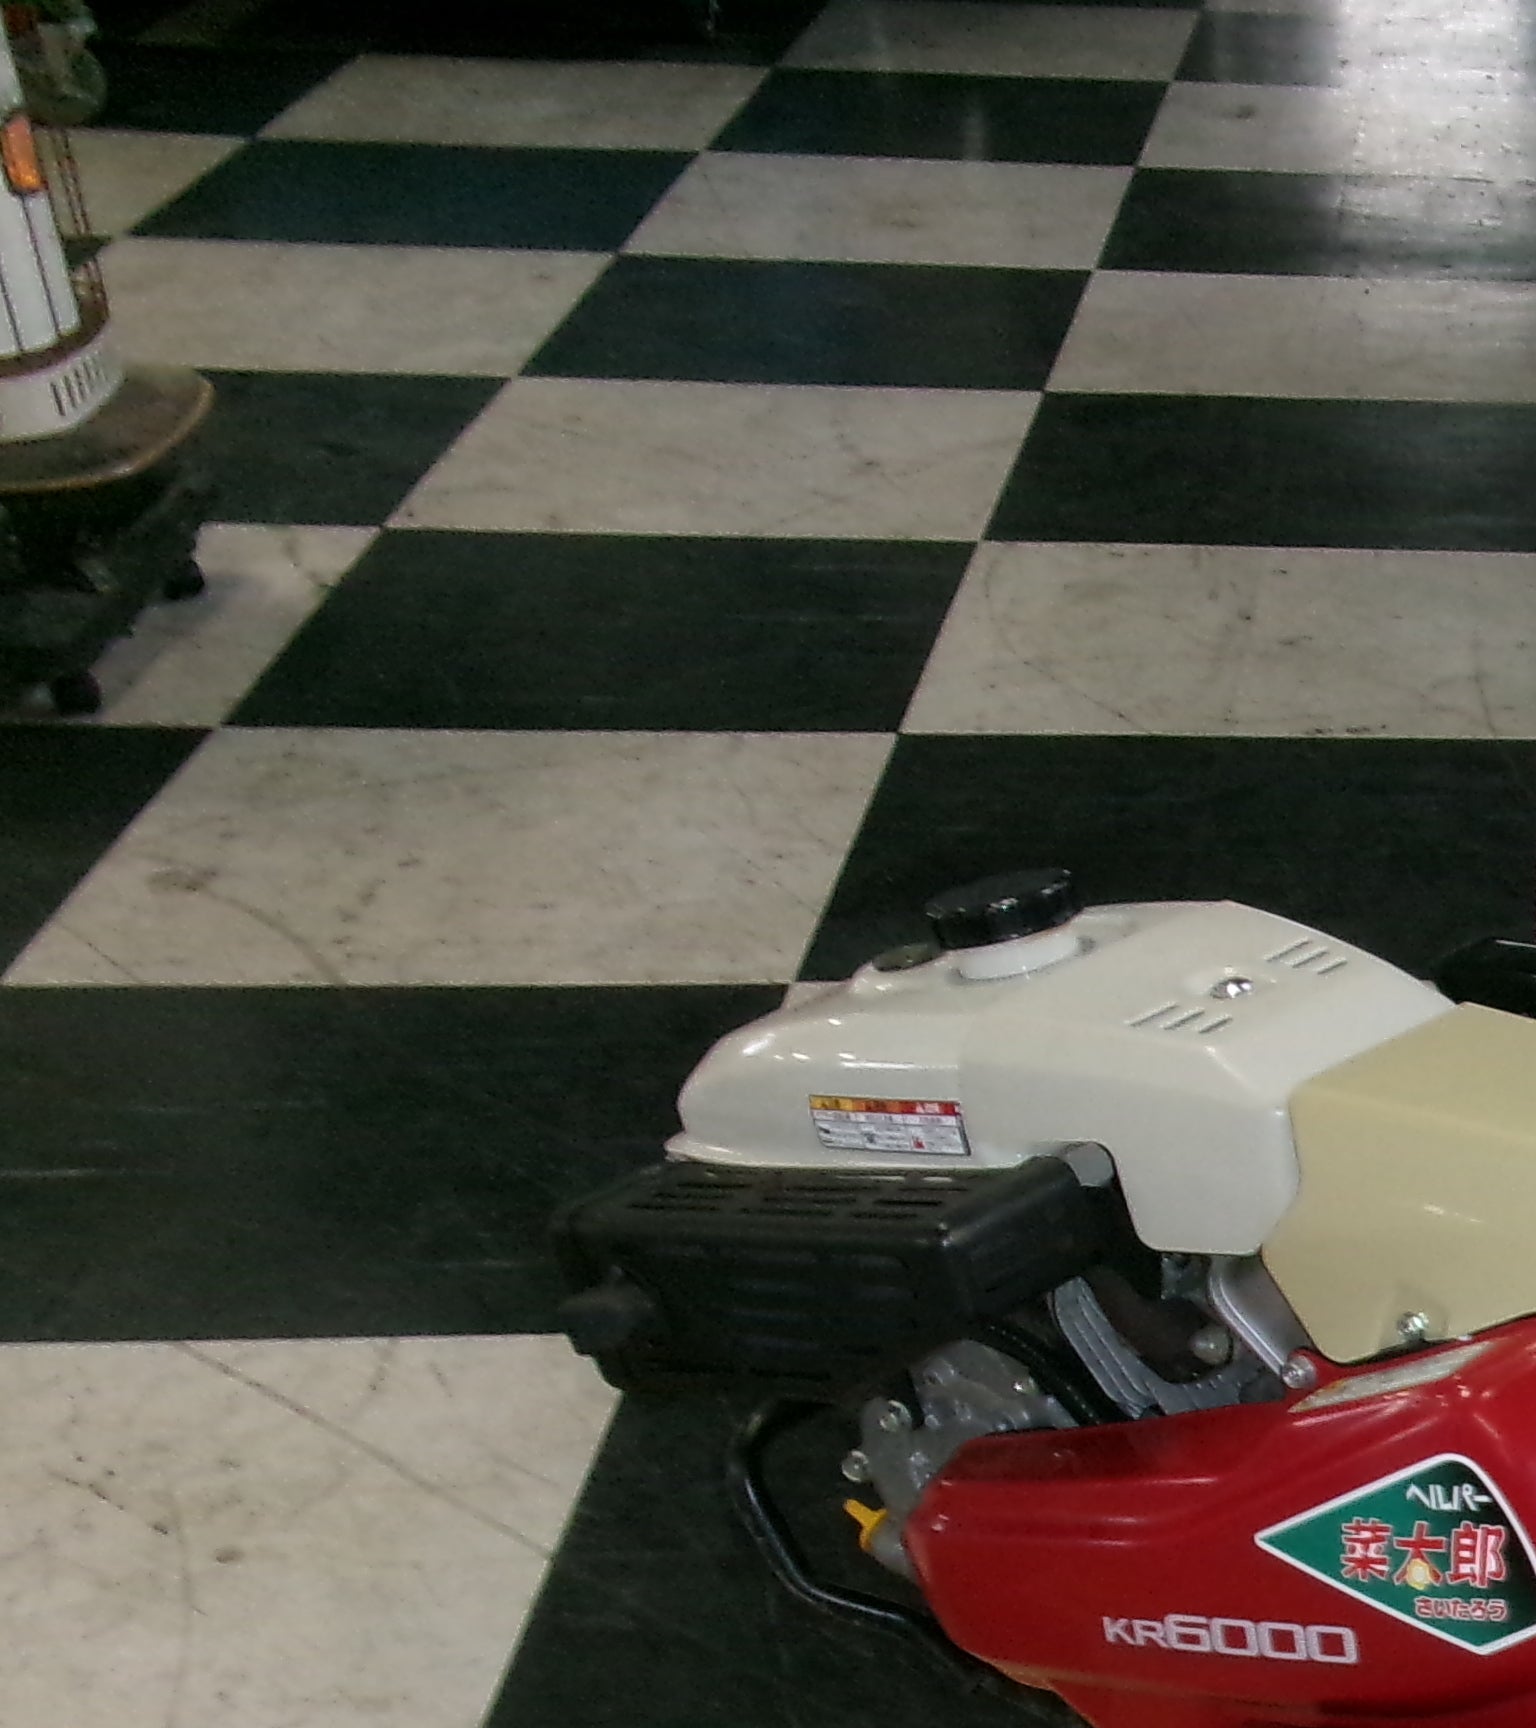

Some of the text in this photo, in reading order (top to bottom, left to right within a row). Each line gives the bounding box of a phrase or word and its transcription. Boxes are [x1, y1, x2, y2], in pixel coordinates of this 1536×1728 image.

[1406, 1483, 1494, 1512] ヘルパー
[1339, 1516, 1507, 1590] 菜太郎
[1414, 1595, 1508, 1622] さいたろう
[1101, 1613, 1359, 1666] KR6000
